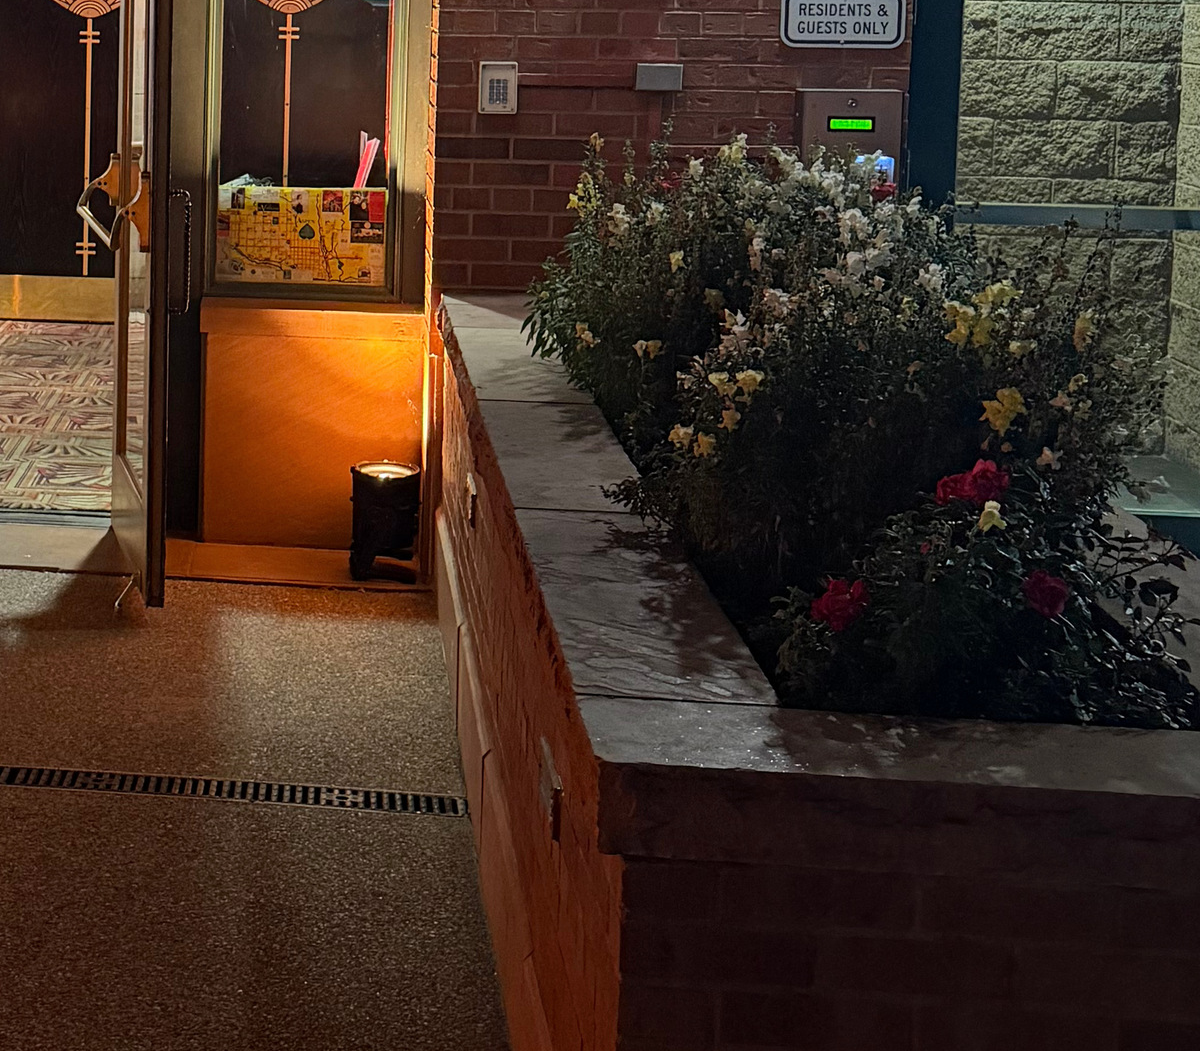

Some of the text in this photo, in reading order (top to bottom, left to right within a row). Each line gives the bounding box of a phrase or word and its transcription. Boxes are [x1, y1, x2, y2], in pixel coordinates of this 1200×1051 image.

[798, 3, 889, 17] RESIDENTS &
[797, 21, 889, 35] GUESTS ONLY
